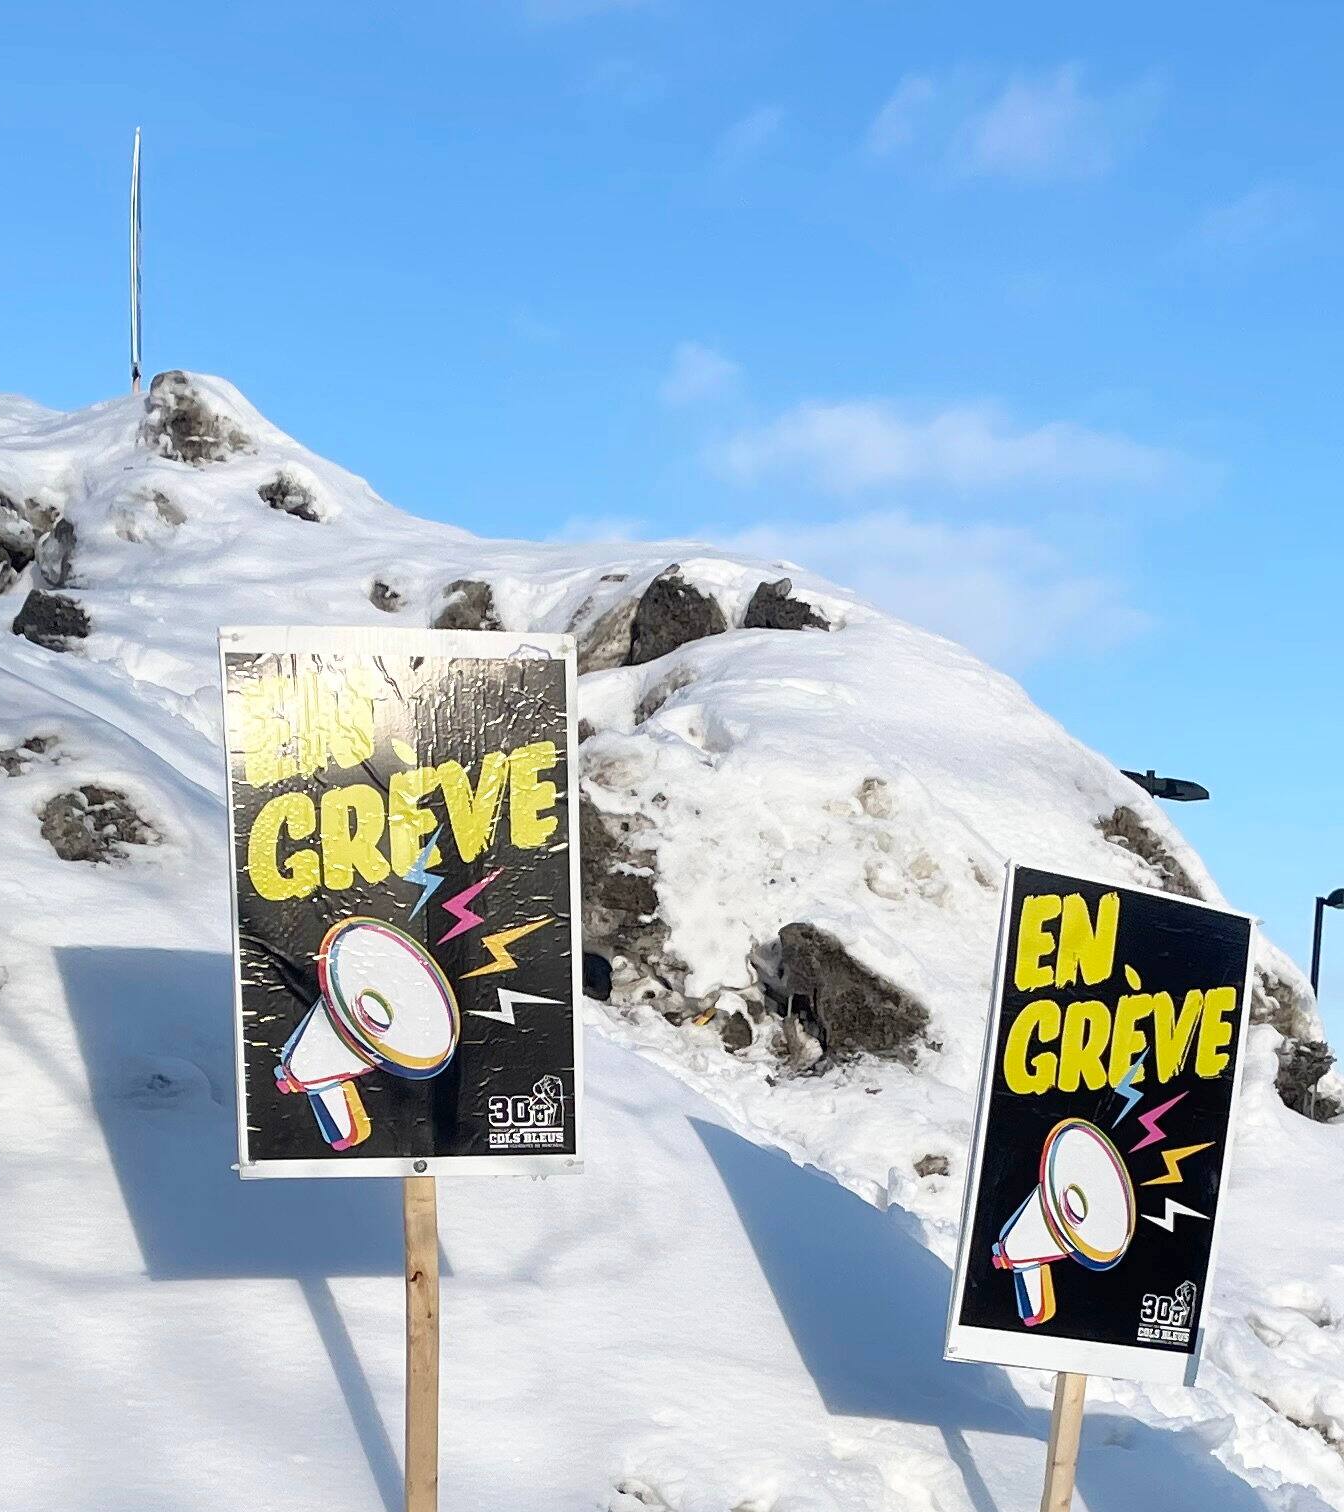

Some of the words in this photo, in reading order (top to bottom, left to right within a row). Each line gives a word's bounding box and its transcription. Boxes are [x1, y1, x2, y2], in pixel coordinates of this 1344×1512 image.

[242, 669, 375, 789] EN
[246, 738, 560, 901] GRÈVE
[1014, 892, 1120, 992] EN
[1004, 964, 1237, 1096] GRÈVE
[489, 1133, 521, 1144] COLS
[523, 1132, 564, 1144] BLEUS
